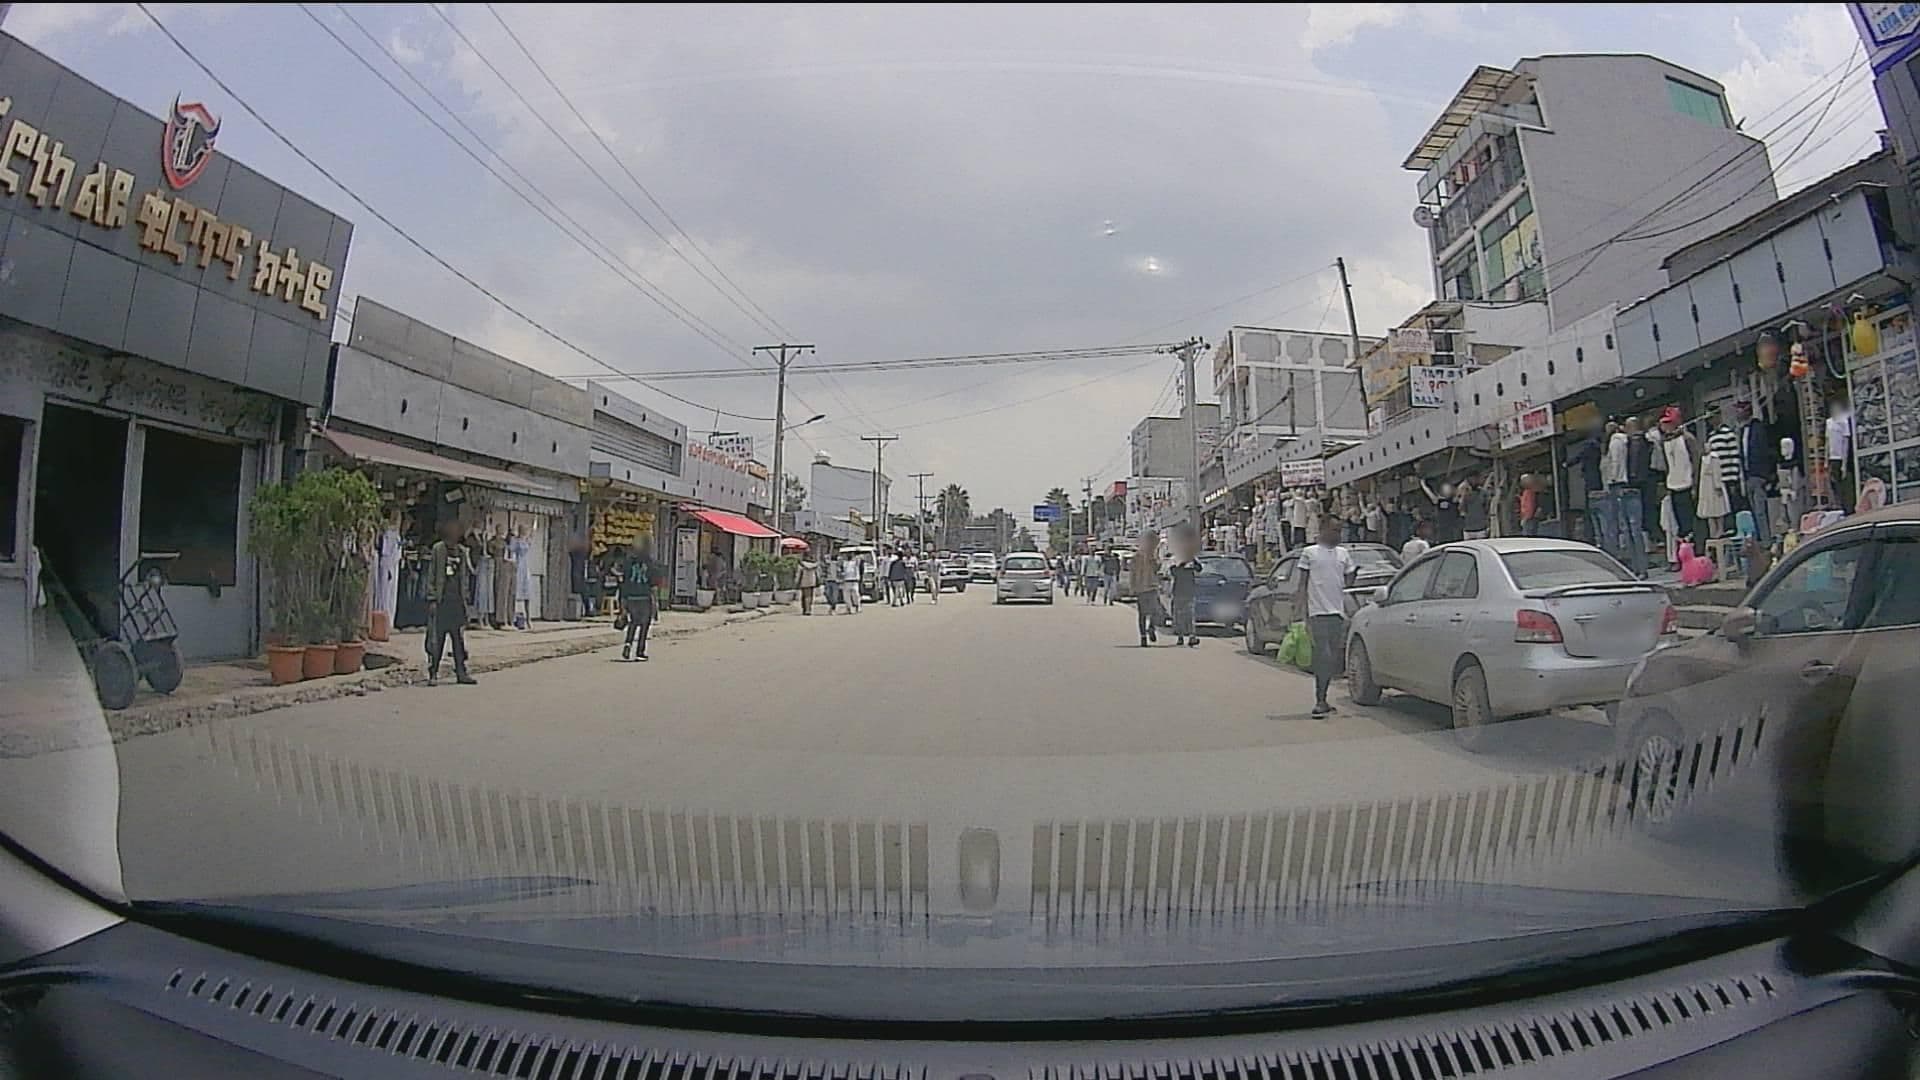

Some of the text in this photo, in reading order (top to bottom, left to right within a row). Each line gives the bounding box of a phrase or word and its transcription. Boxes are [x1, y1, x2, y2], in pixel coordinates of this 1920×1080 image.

[0, 96, 76, 208] ሮኒካ
[73, 162, 135, 228] ልዩ
[252, 240, 334, 321] ክትፎ
